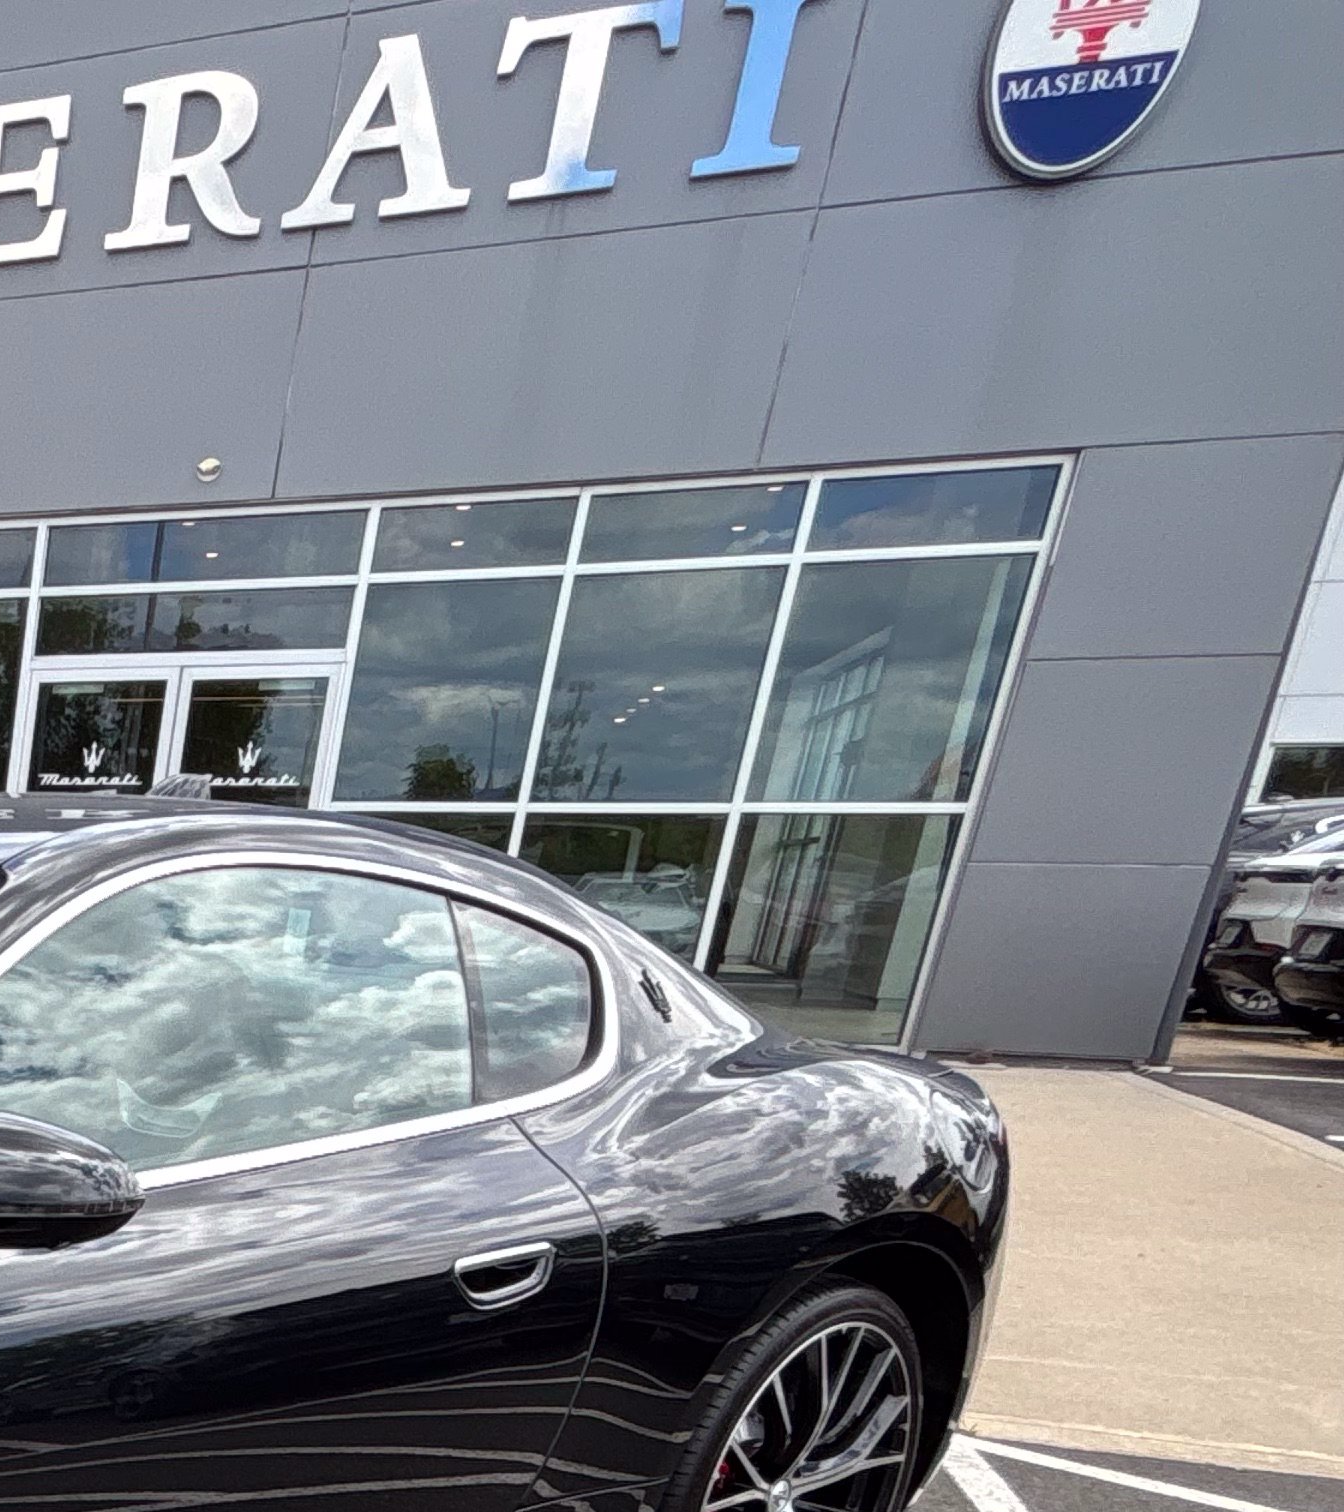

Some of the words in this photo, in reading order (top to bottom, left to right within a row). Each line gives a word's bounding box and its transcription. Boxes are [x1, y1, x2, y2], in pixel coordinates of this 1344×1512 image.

[1002, 60, 1166, 103] MASERATI
[37, 773, 143, 786] Maserati
[208, 773, 301, 787] aserati
